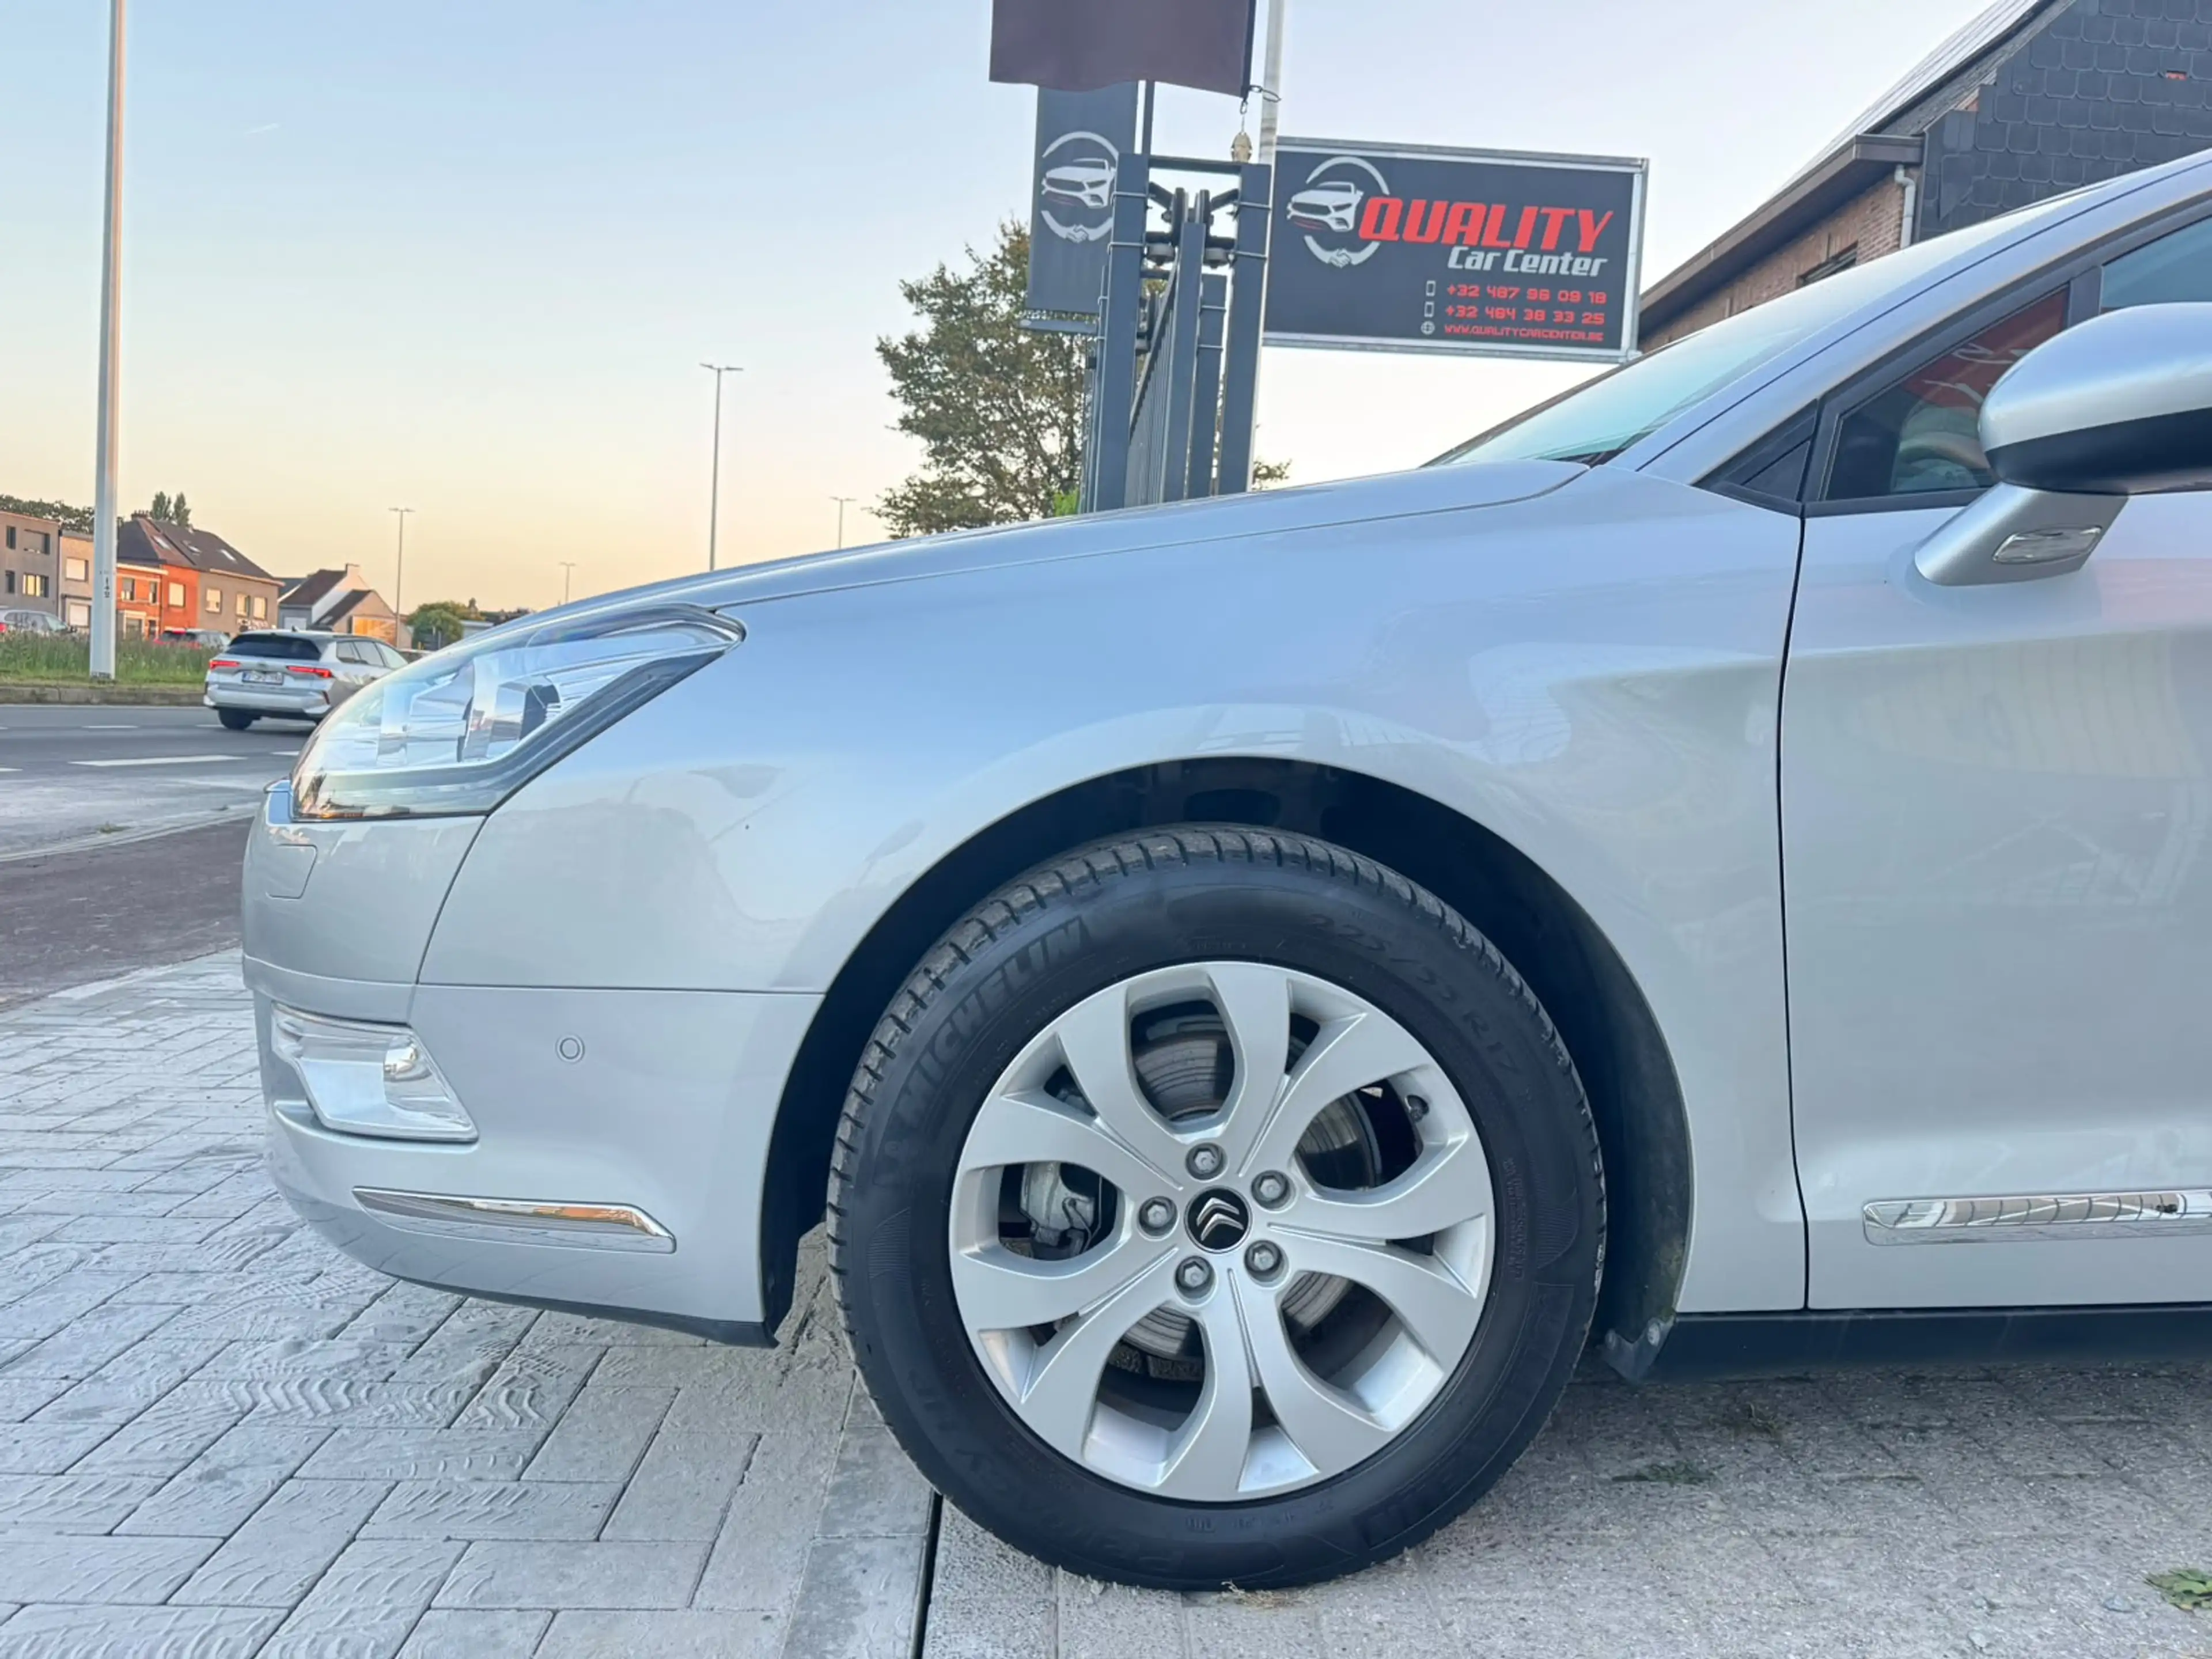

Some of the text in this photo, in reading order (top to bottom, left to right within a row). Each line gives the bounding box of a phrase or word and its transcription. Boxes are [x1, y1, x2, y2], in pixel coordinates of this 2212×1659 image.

[1358, 196, 1613, 252] QUALITY
[1447, 246, 1608, 277] Car Center
[1447, 284, 1480, 297] +32
[1445, 305, 1478, 318] +32
[1552, 310, 1575, 323] 33
[1581, 312, 1605, 325] 25
[893, 913, 1088, 1130] MICHELIN
